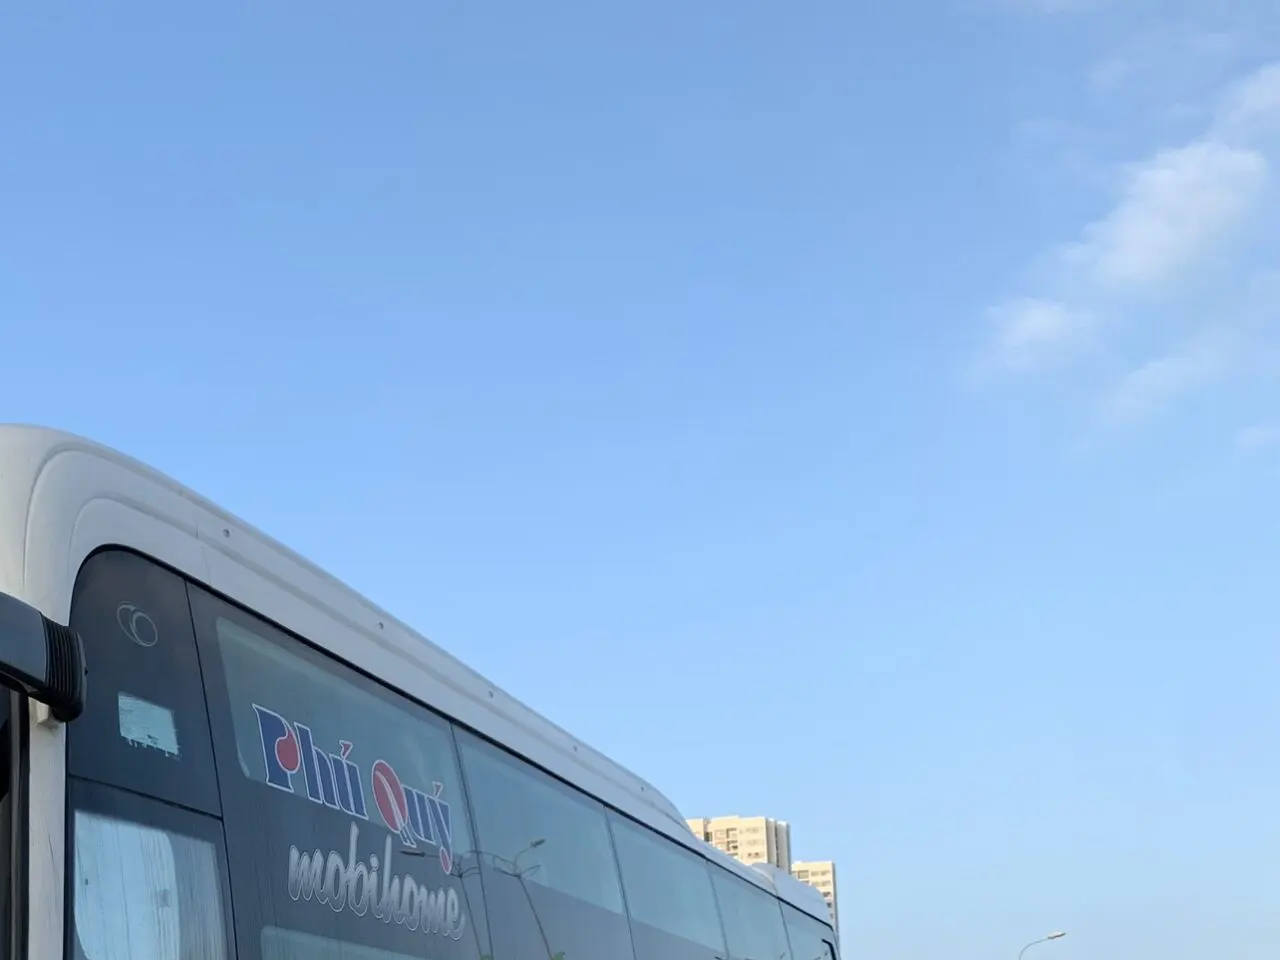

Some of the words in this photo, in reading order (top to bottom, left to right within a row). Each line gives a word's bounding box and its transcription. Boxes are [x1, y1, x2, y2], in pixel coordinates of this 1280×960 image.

[252, 703, 369, 820] Phú
[371, 759, 455, 875] Quý
[288, 821, 466, 941] mobihome
